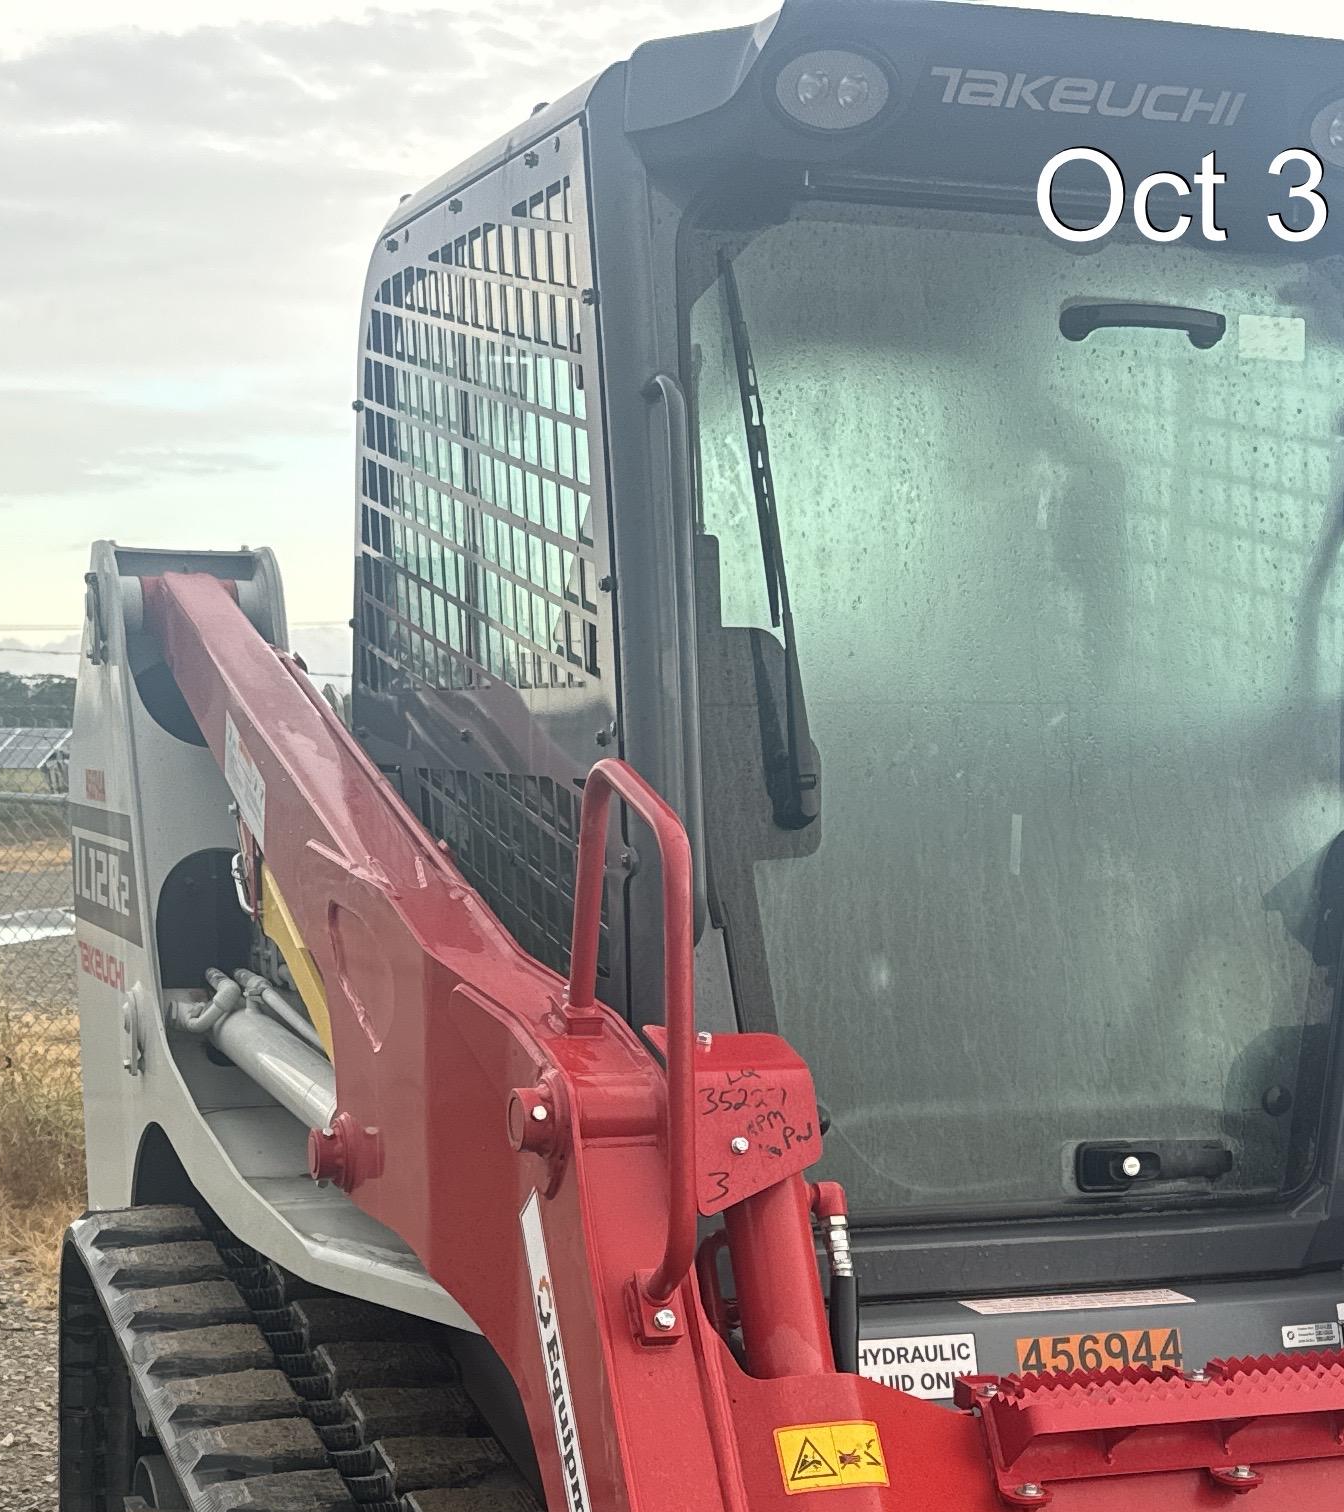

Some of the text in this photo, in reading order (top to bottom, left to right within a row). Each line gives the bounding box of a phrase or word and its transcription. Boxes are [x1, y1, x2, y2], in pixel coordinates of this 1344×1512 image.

[930, 65, 1247, 127] TAKEUCHI
[858, 1342, 971, 1367] HYDRAULIC
[1020, 1328, 1184, 1376] 456944
[864, 1370, 972, 1392] UID ON
